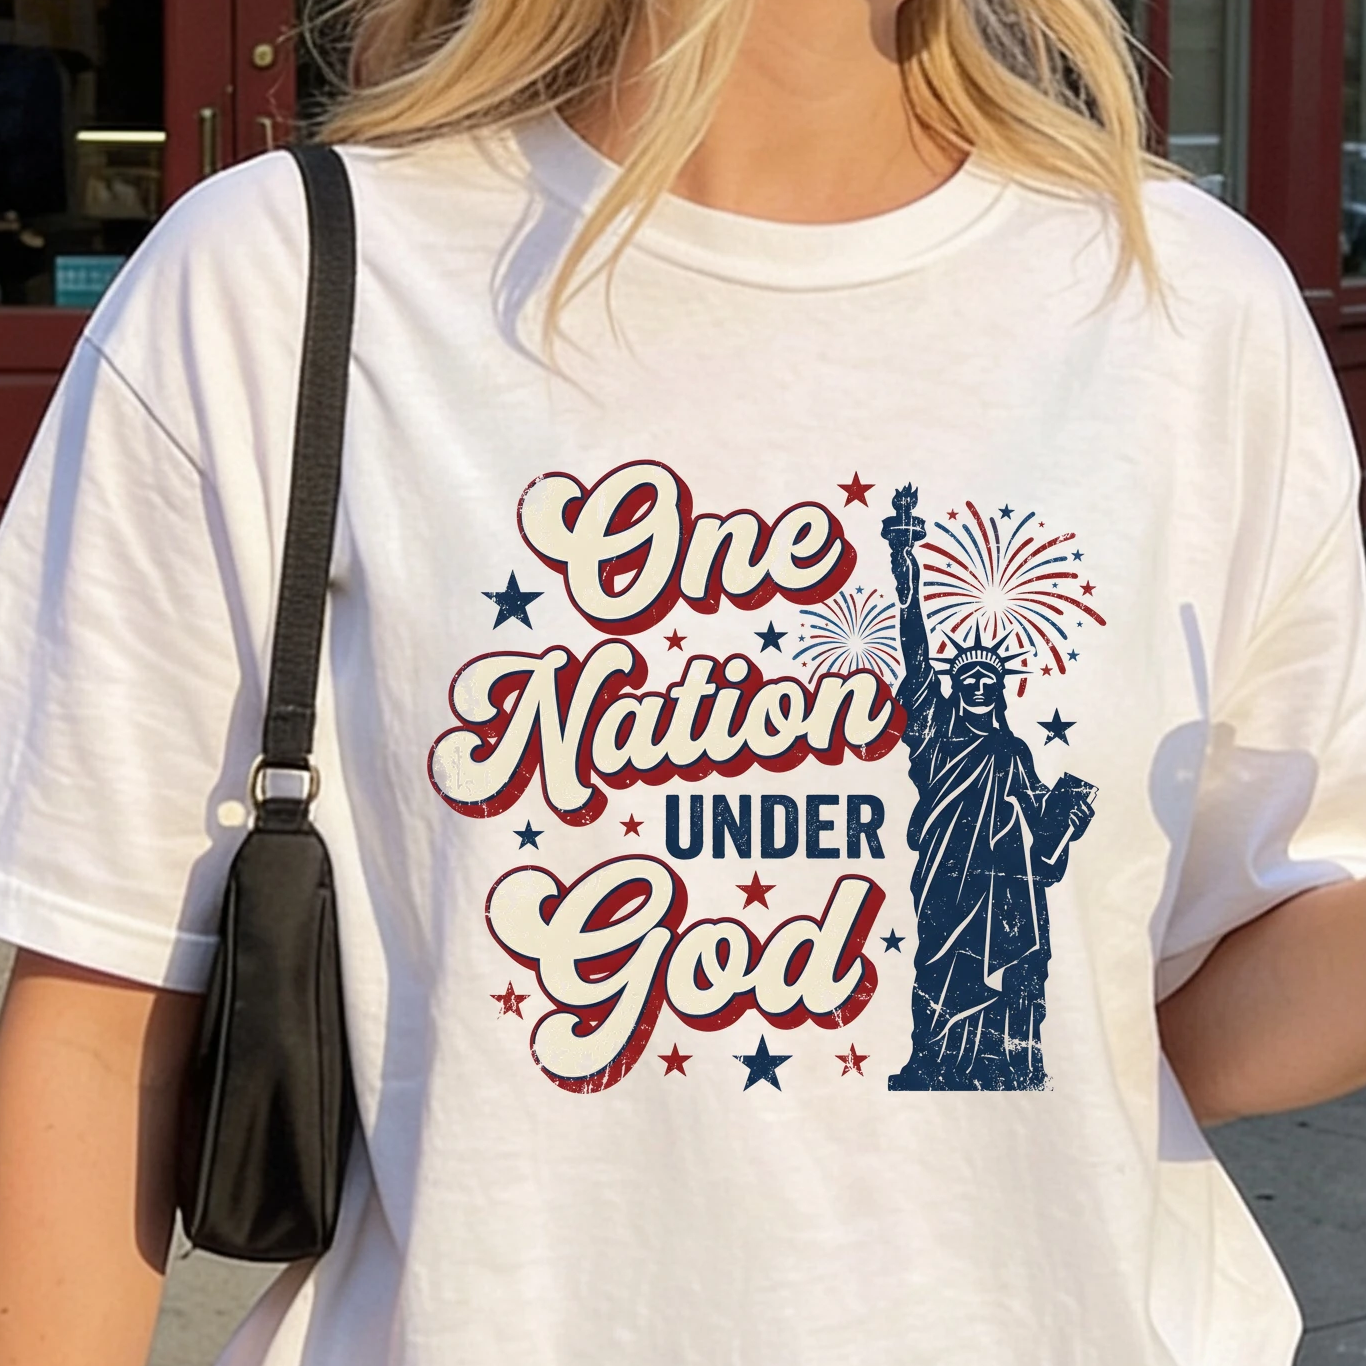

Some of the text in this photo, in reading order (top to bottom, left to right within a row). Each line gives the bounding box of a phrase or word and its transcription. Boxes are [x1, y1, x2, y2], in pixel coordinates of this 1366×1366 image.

[517, 459, 857, 635] One
[427, 638, 907, 827] Nation
[665, 794, 886, 859] UNDER
[485, 854, 886, 1094] God
